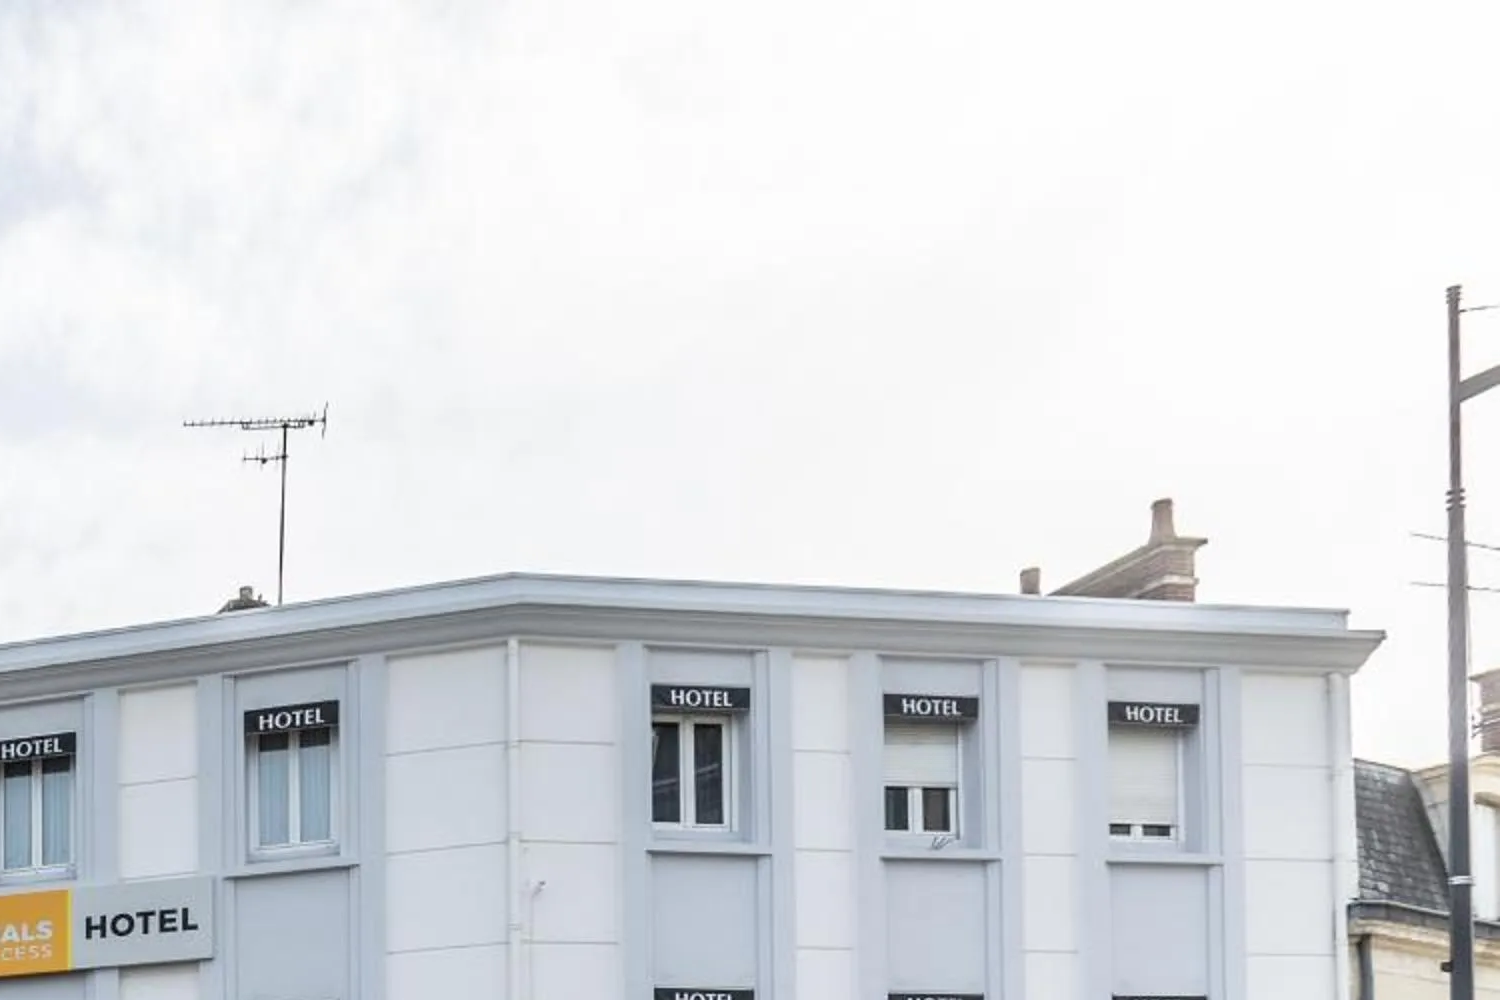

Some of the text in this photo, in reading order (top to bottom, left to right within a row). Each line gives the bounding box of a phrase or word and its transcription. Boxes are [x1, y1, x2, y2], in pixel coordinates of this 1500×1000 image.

[670, 689, 733, 707] HOTEL
[901, 698, 962, 717] HOTEL
[259, 707, 325, 731] HOTEL
[1125, 705, 1184, 724] HOTEL
[1, 737, 63, 759] HOTEL
[85, 907, 199, 940] HOTEL
